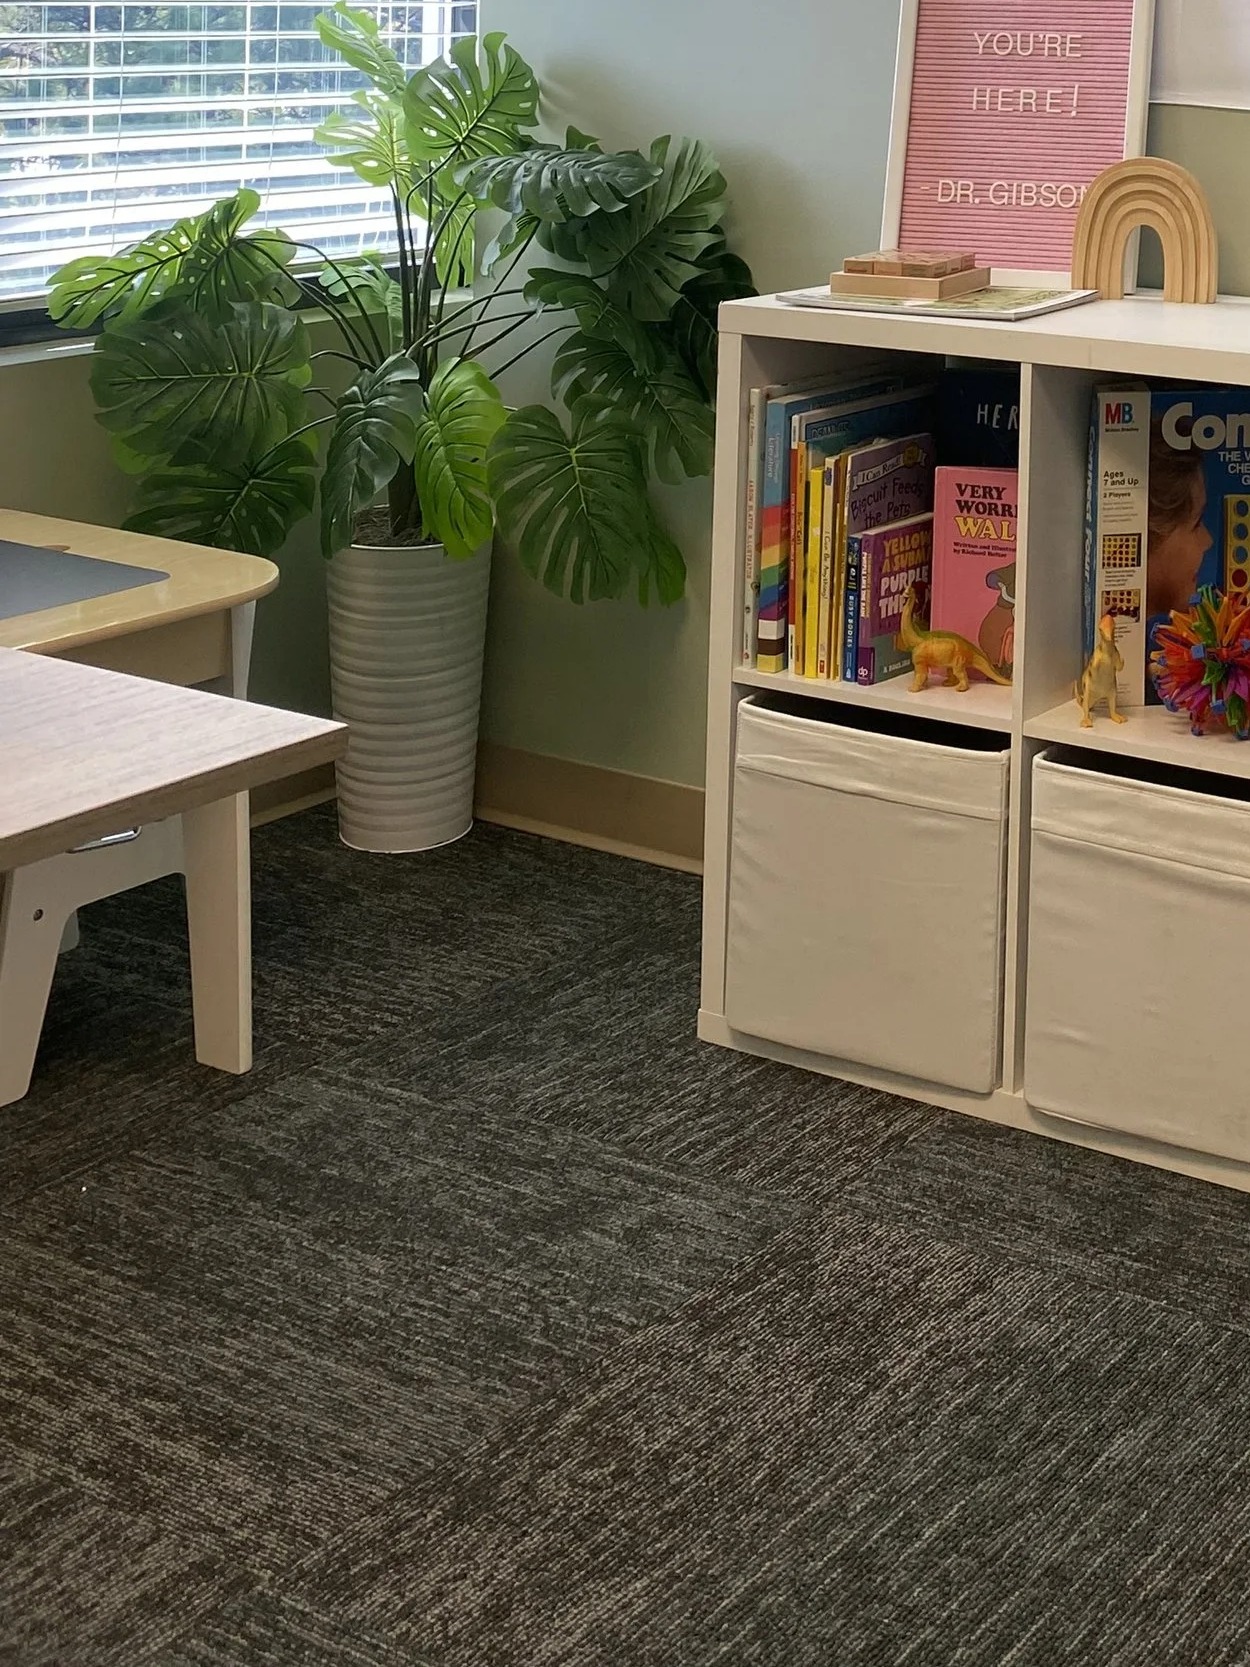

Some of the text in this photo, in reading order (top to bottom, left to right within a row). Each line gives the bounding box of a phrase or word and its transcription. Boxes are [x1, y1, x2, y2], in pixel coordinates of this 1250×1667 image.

[974, 32, 1083, 58] YOU'RE
[972, 84, 1079, 117] HERE!
[1104, 402, 1133, 425] MB
[1218, 451, 1241, 462] THE
[1103, 470, 1124, 479] Ages
[1111, 478, 1139, 487] and Up
[851, 477, 925, 521] Biscuit Feeds
[955, 483, 1007, 500] VERY
[864, 501, 911, 529] the Pets
[954, 516, 1017, 541] WAL
[883, 531, 932, 556] YELLOW
[880, 565, 928, 596] PURPLE
